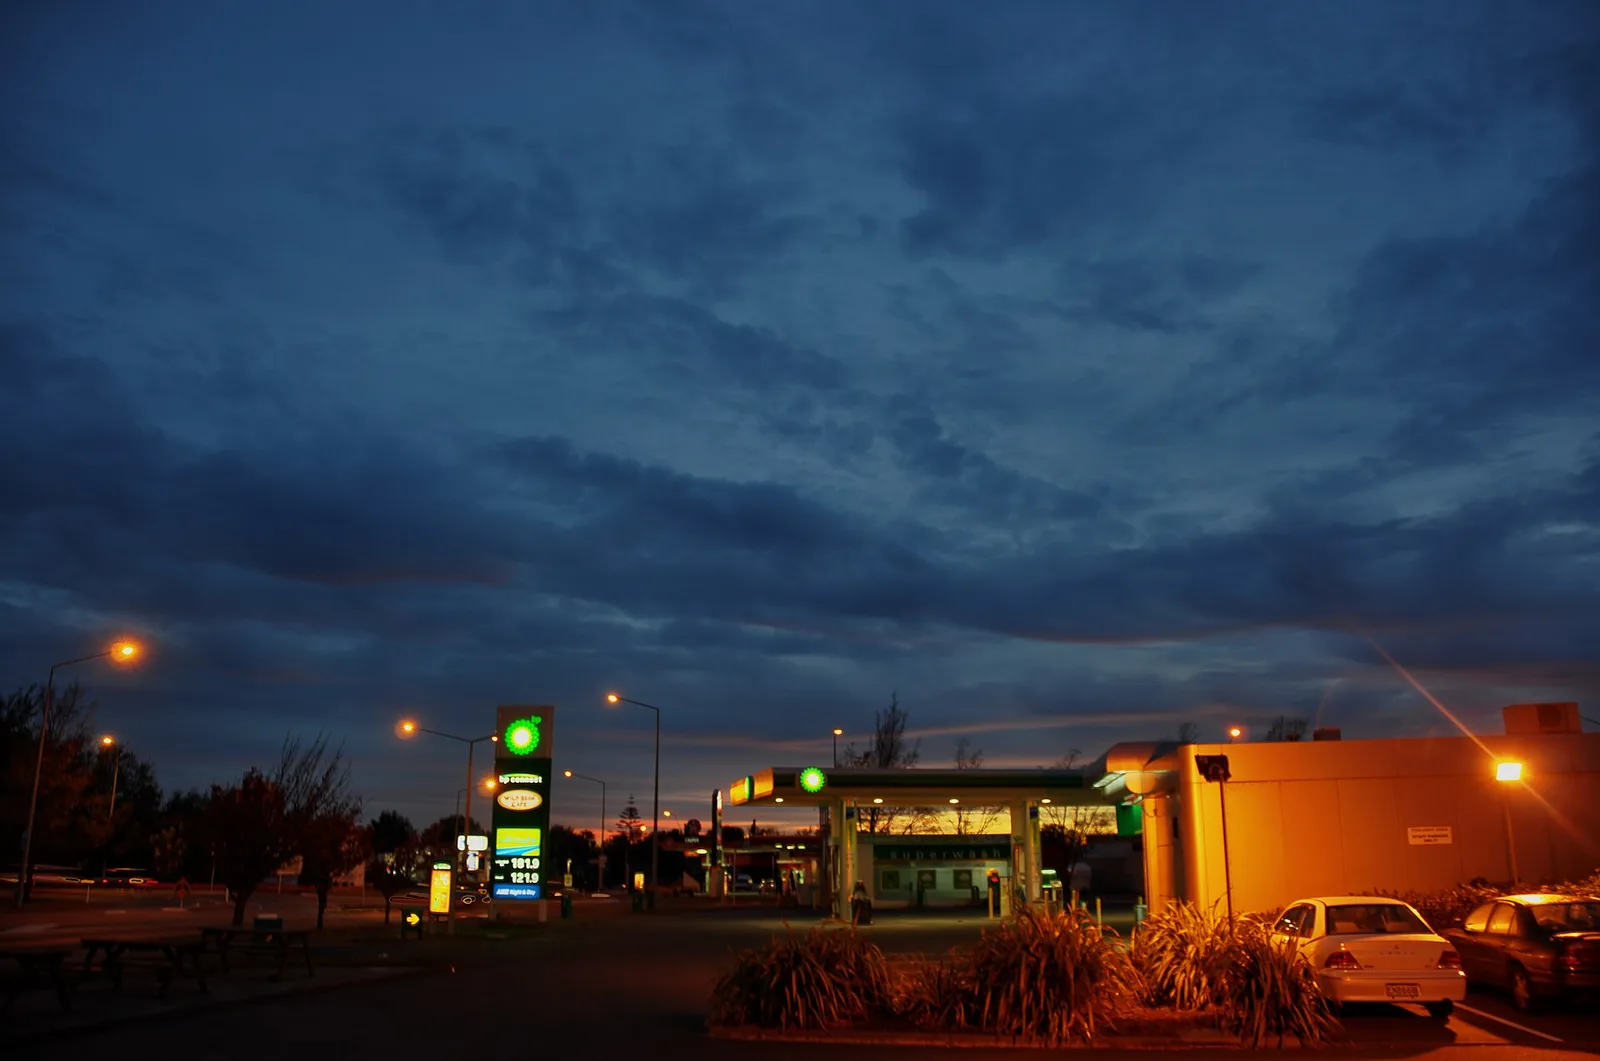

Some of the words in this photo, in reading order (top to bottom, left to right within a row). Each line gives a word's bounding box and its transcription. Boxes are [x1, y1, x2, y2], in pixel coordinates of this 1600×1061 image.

[531, 715, 542, 725] bp
[499, 775, 509, 784] bp
[890, 848, 1001, 860] superwash
[510, 872, 539, 884] 121.9
